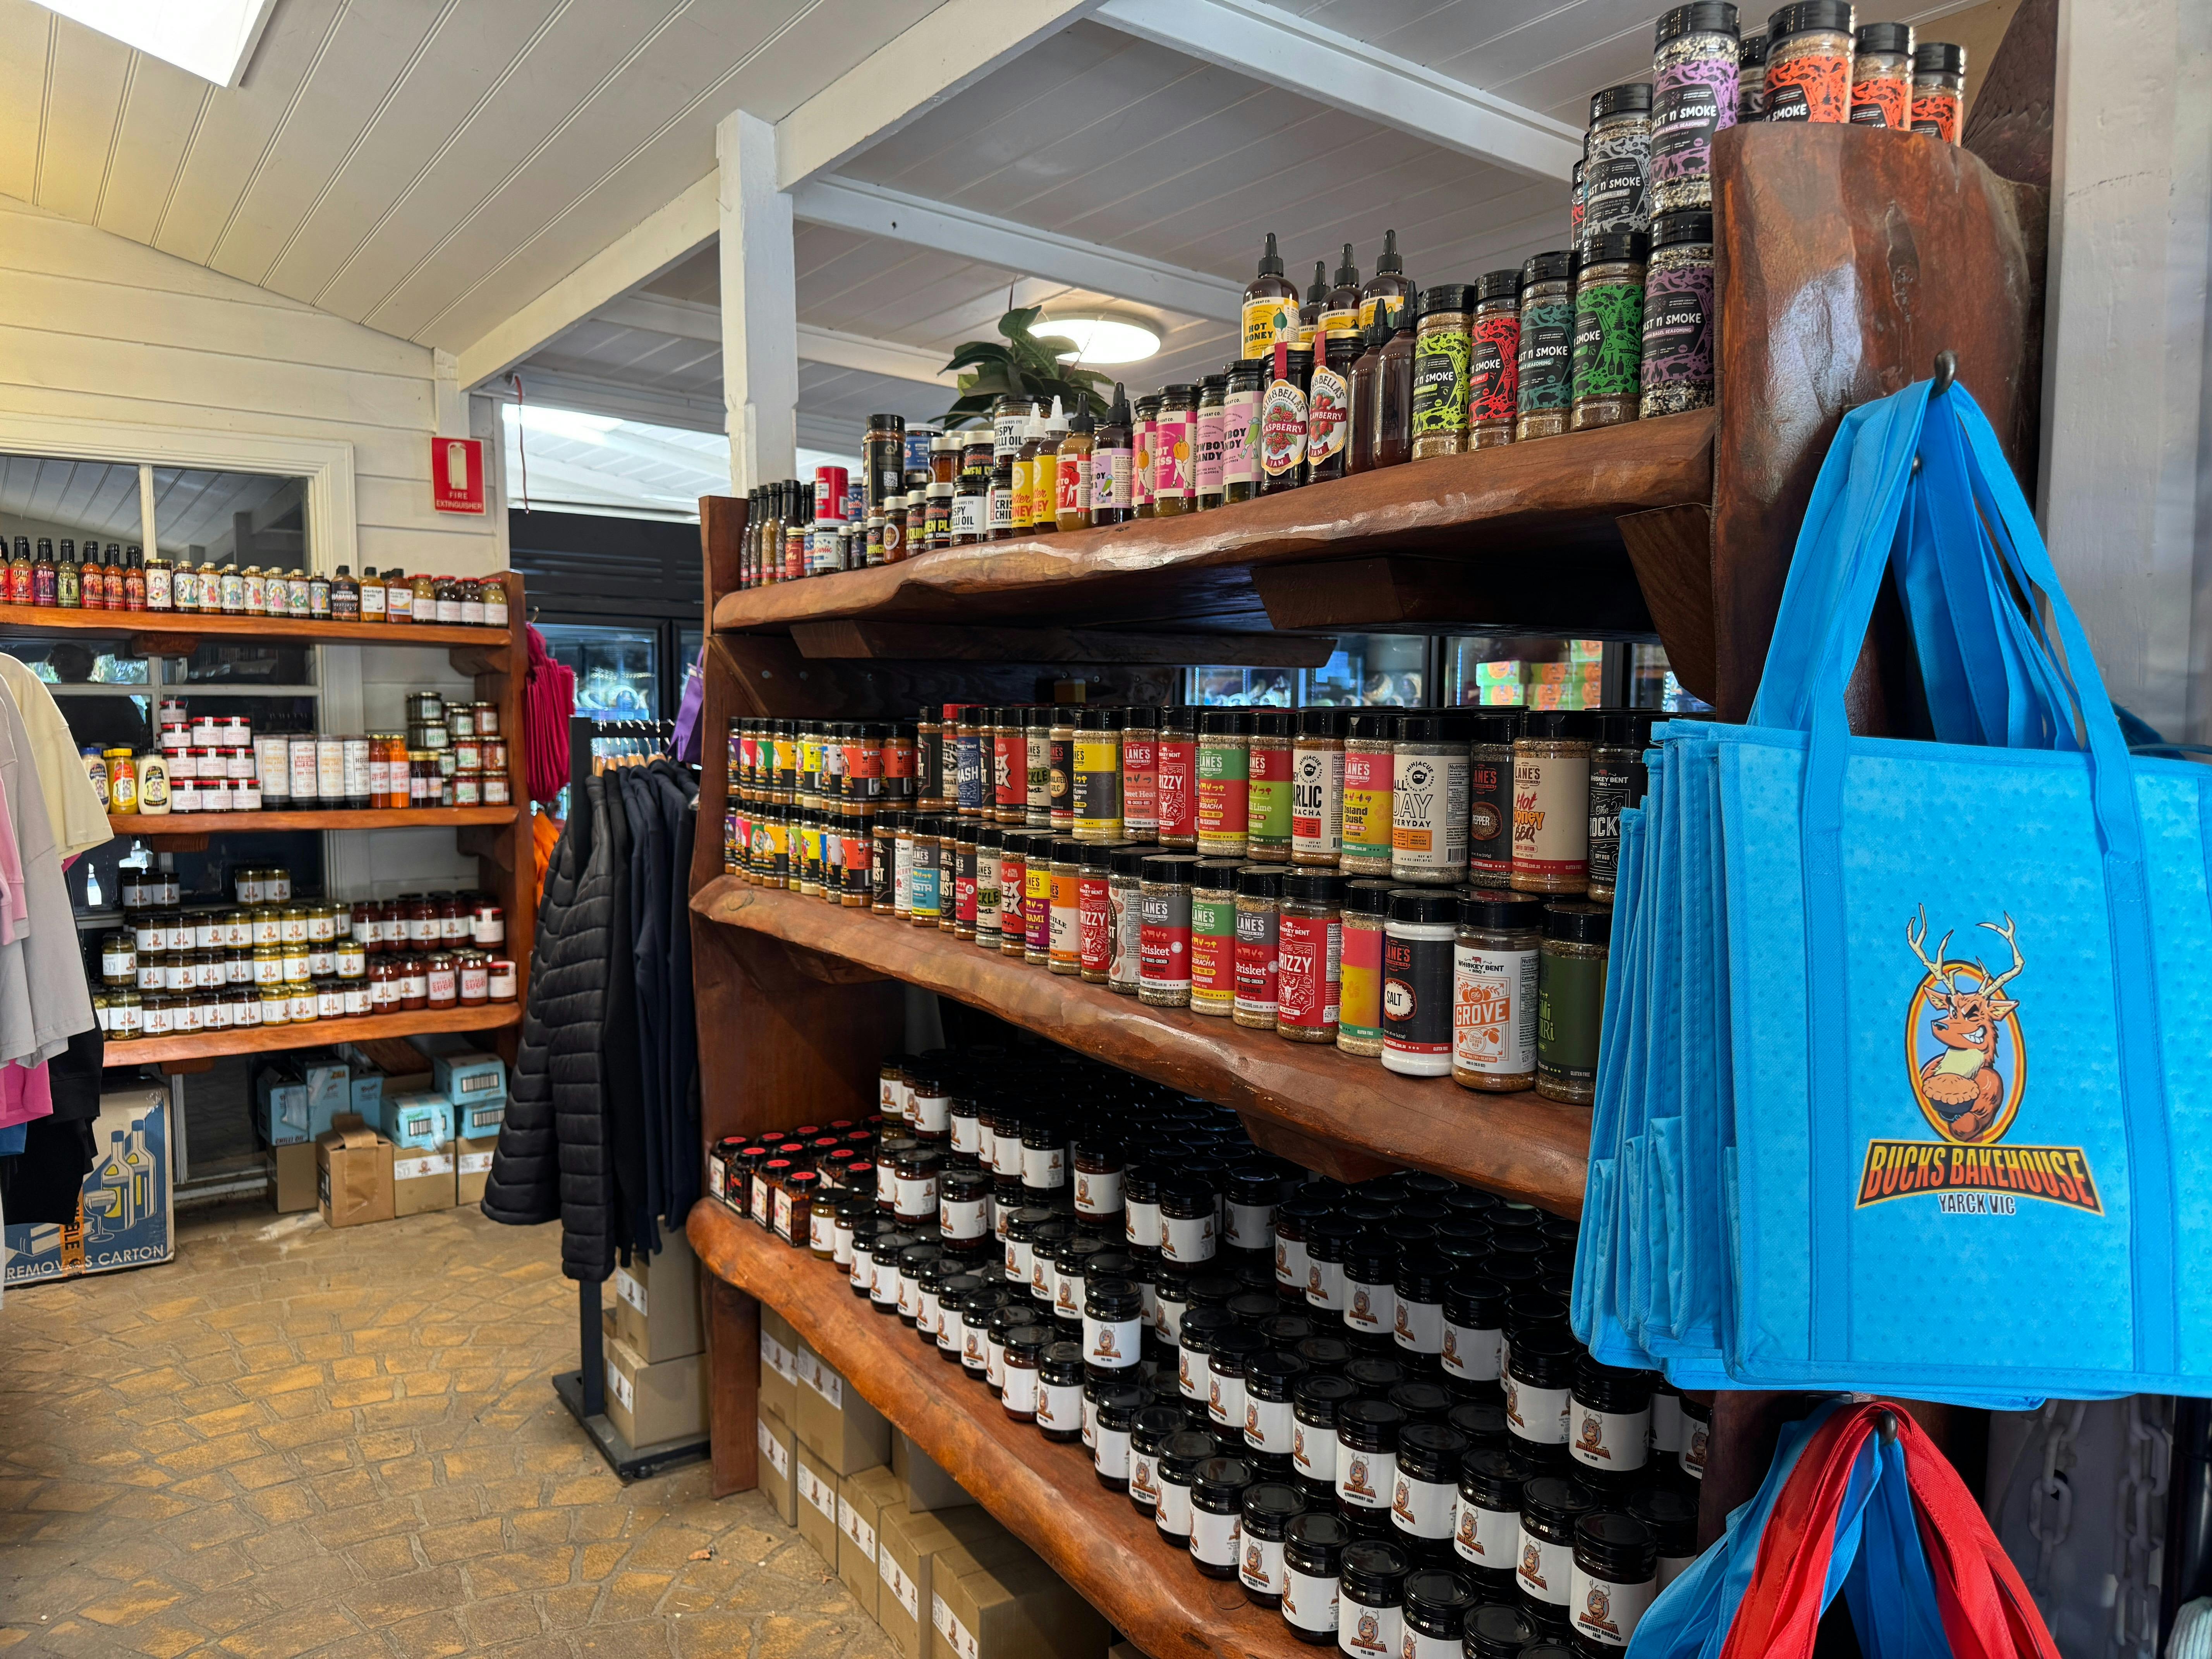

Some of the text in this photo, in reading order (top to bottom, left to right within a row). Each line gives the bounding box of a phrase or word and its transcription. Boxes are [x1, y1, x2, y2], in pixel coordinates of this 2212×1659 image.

[1680, 105, 1717, 118] SMOKE
[1772, 103, 1807, 122] SMOKE
[1609, 177, 1641, 188] SMOKE
[1666, 313, 1702, 325] SMOKE
[1249, 322, 1267, 333] HOT
[1245, 331, 1273, 344] HONEY
[1576, 330, 1601, 345] SMOKE
[1536, 346, 1568, 357] SMOKE
[1475, 359, 1501, 372] SMOKE
[1425, 371, 1453, 383] SMOKE
[1263, 423, 1303, 436] RASPBERRY
[1009, 436, 1023, 445] OIL
[1311, 448, 1322, 456] JAM
[1270, 459, 1284, 467] JAM
[449, 491, 468, 500] FIRE
[436, 499, 482, 510] EXTINGUISHER
[962, 516, 974, 525] OIL
[38, 570, 55, 579] BARD
[1125, 749, 1150, 760] LANE'S
[1299, 755, 1322, 767] NINJACUE
[1406, 761, 1434, 773] NINJACUE
[1516, 766, 1540, 780] LANE'S
[1159, 775, 1183, 790] RIZZY
[1394, 779, 1408, 791] ALL
[1405, 775, 1417, 792] ORIGINAL
[1201, 796, 1218, 804] Honey
[1516, 791, 1538, 811] Hot
[1254, 803, 1272, 812] Lime
[1345, 805, 1368, 816] Island
[1595, 805, 1609, 815] The
[1345, 814, 1364, 824] Dust
[1473, 814, 1490, 826] PEPPER
[1514, 807, 1545, 831] Honey
[1515, 826, 1535, 843] BBQ
[1142, 901, 1168, 915] LANE'S
[1237, 916, 1264, 932] LANE'S
[1141, 944, 1170, 956] Brisket
[1193, 951, 1210, 960] Honey
[1236, 962, 1266, 976] Brisket
[1458, 959, 1484, 970] WHISKEY
[1387, 990, 1402, 1006] SALT
[1456, 1000, 1506, 1026] GROVE
[1863, 1145, 2095, 1207] BUCKS BAKEHOUSE
[1937, 1193, 2016, 1214] YARCK VIC
[98, 1243, 164, 1266] CARTON
[1577, 1621, 1601, 1633] STRAWBERRY
